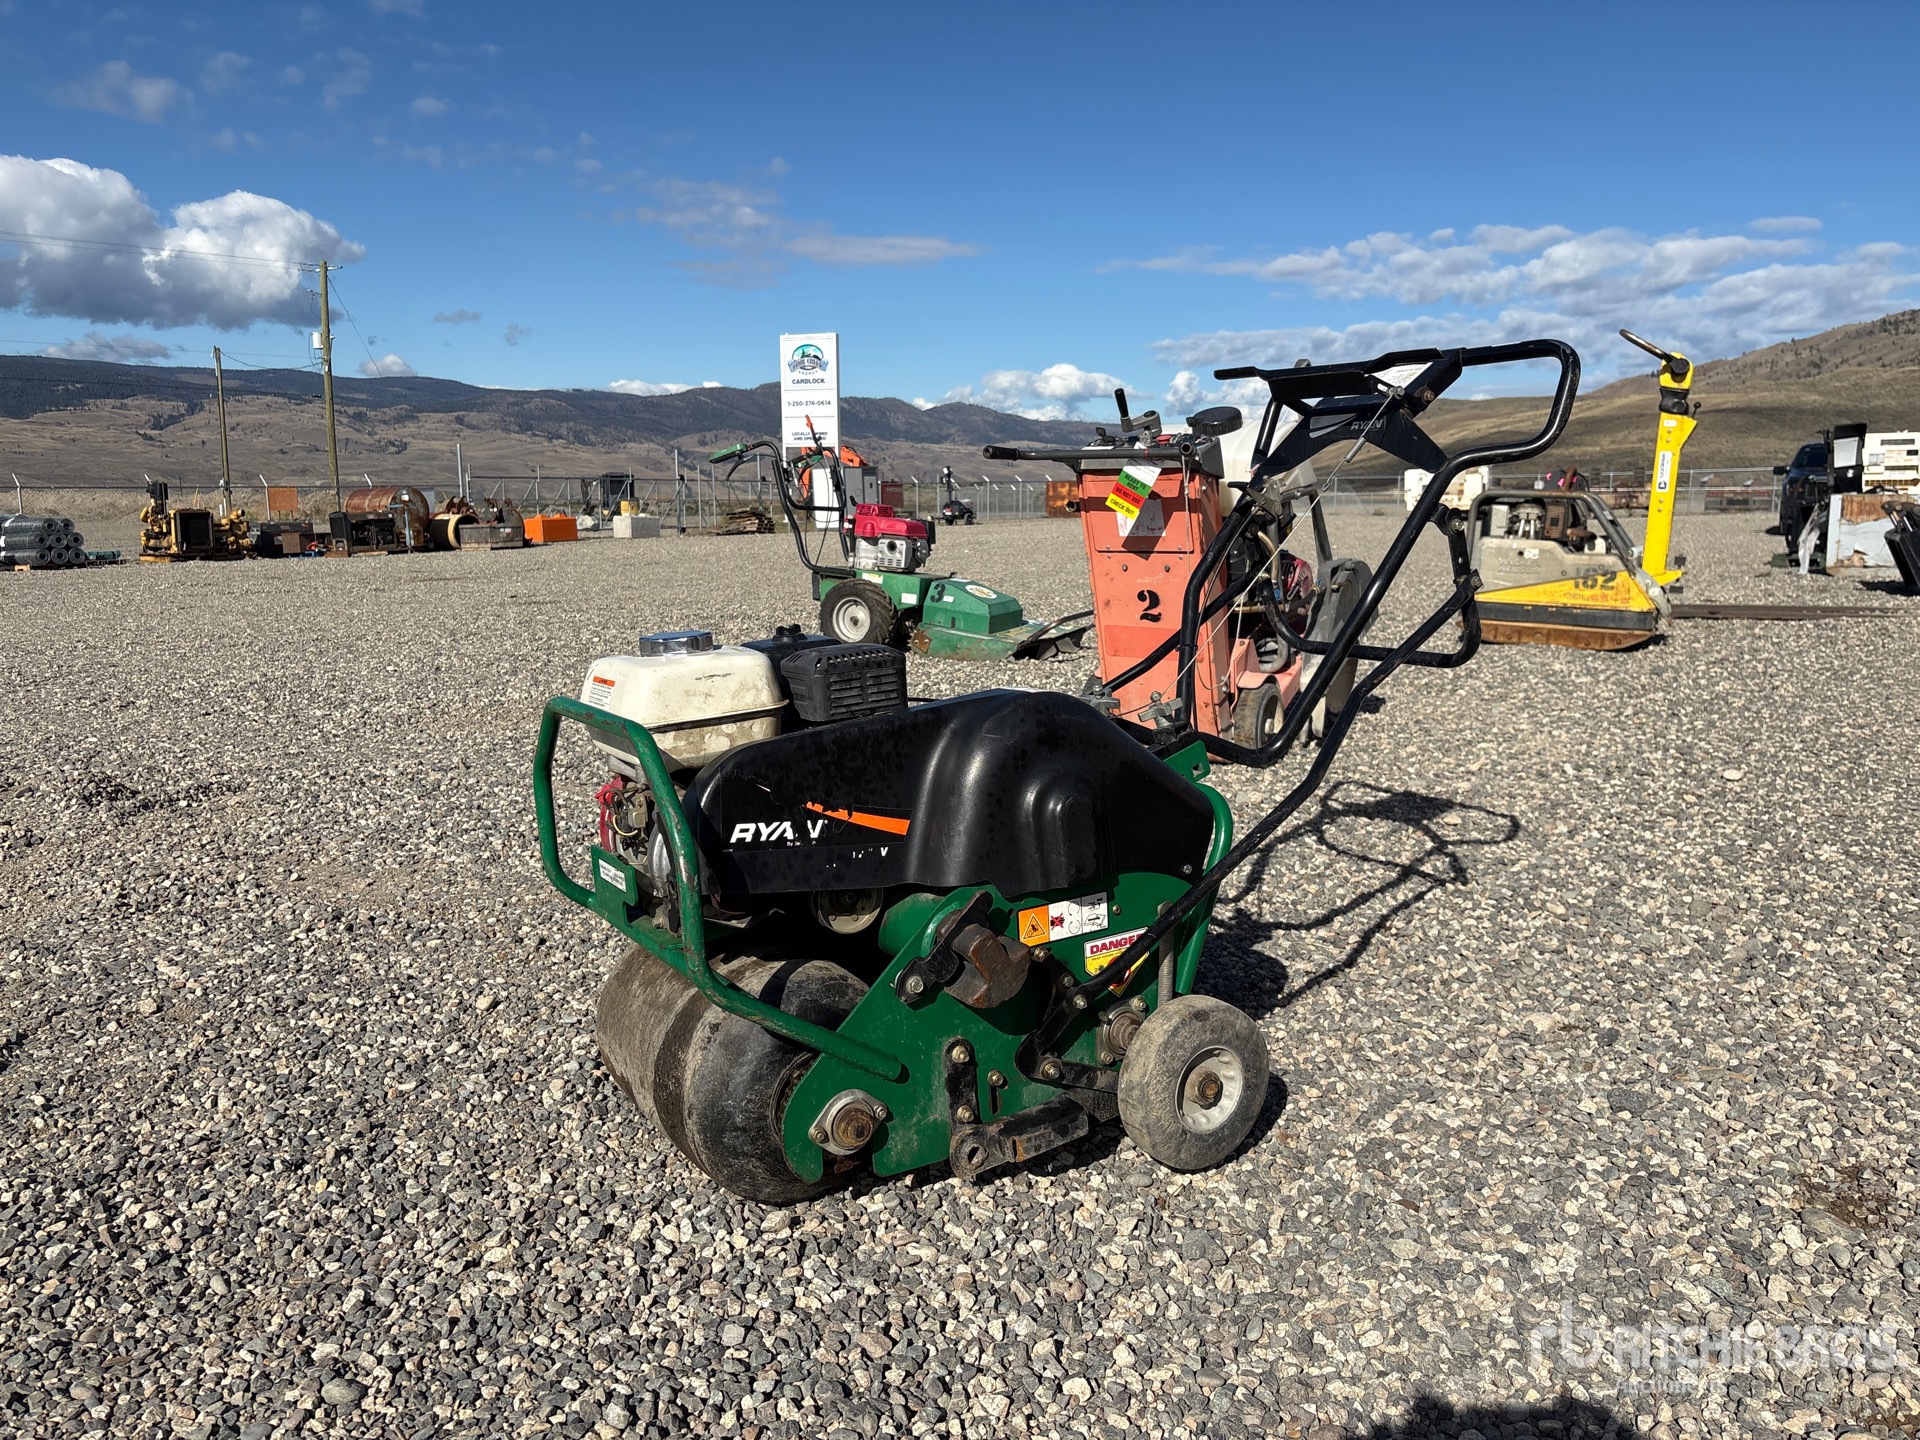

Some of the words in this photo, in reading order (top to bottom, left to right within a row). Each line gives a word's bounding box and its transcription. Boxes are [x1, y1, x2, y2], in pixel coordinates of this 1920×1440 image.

[1350, 419, 1384, 431] RYAN
[1110, 498, 1126, 511] CHECK
[1124, 507, 1135, 516] OUT
[930, 584, 946, 603] 3
[1137, 589, 1162, 623] 2
